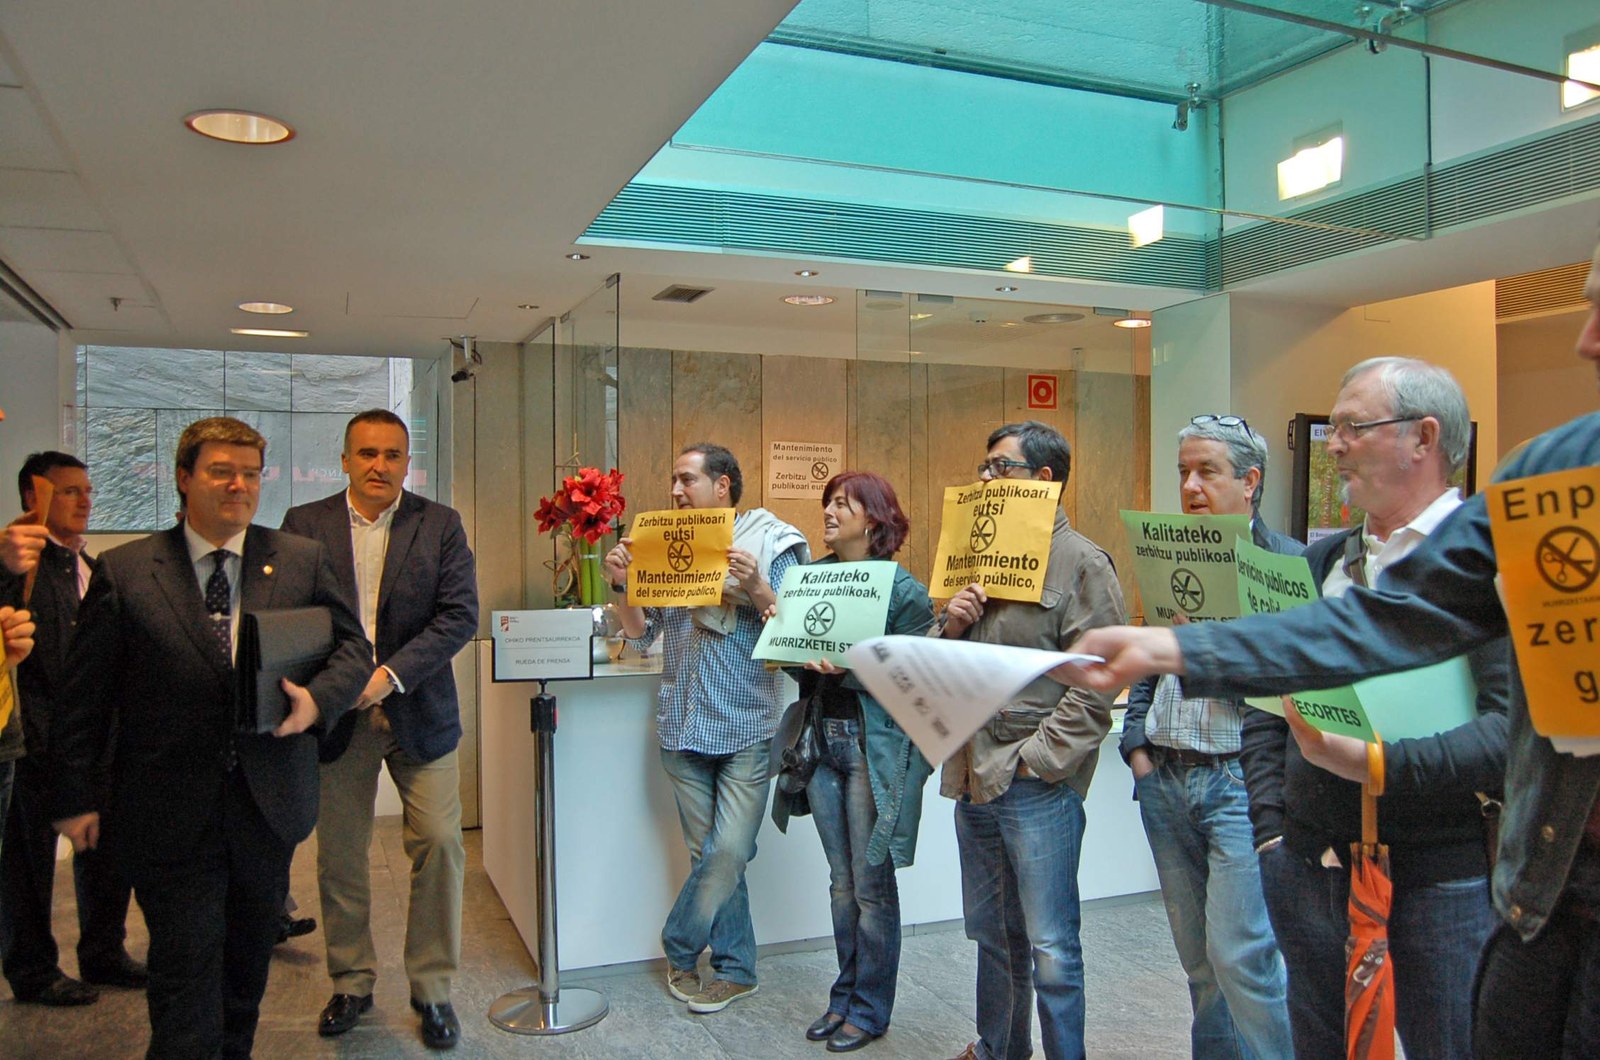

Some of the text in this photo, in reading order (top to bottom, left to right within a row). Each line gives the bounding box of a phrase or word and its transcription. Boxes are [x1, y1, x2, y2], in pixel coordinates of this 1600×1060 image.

[773, 443, 833, 453] Mantenimiento
[776, 472, 807, 481] Zerbitzu
[771, 482, 810, 490] publikoari
[957, 485, 1050, 505] Zerbitzu publikoari
[973, 499, 1006, 517] eutsi
[638, 513, 726, 529] Zerbitzu publikoari
[663, 526, 695, 541] eutsi
[1142, 522, 1222, 544] Kalitateko
[1136, 545, 1173, 561] zerbitzu
[946, 551, 1040, 572] Mantenimiento
[637, 570, 722, 584] Mantenimiento
[800, 569, 870, 584] Kalitateko
[983, 572, 1036, 592] público,
[1264, 569, 1309, 600] públicos
[636, 587, 650, 598] del
[652, 587, 686, 598] servicio
[783, 586, 881, 601] zerbitzu publikoak,
[768, 637, 836, 652] MURRIZKETEI
[1291, 698, 1362, 728] ECORTES
